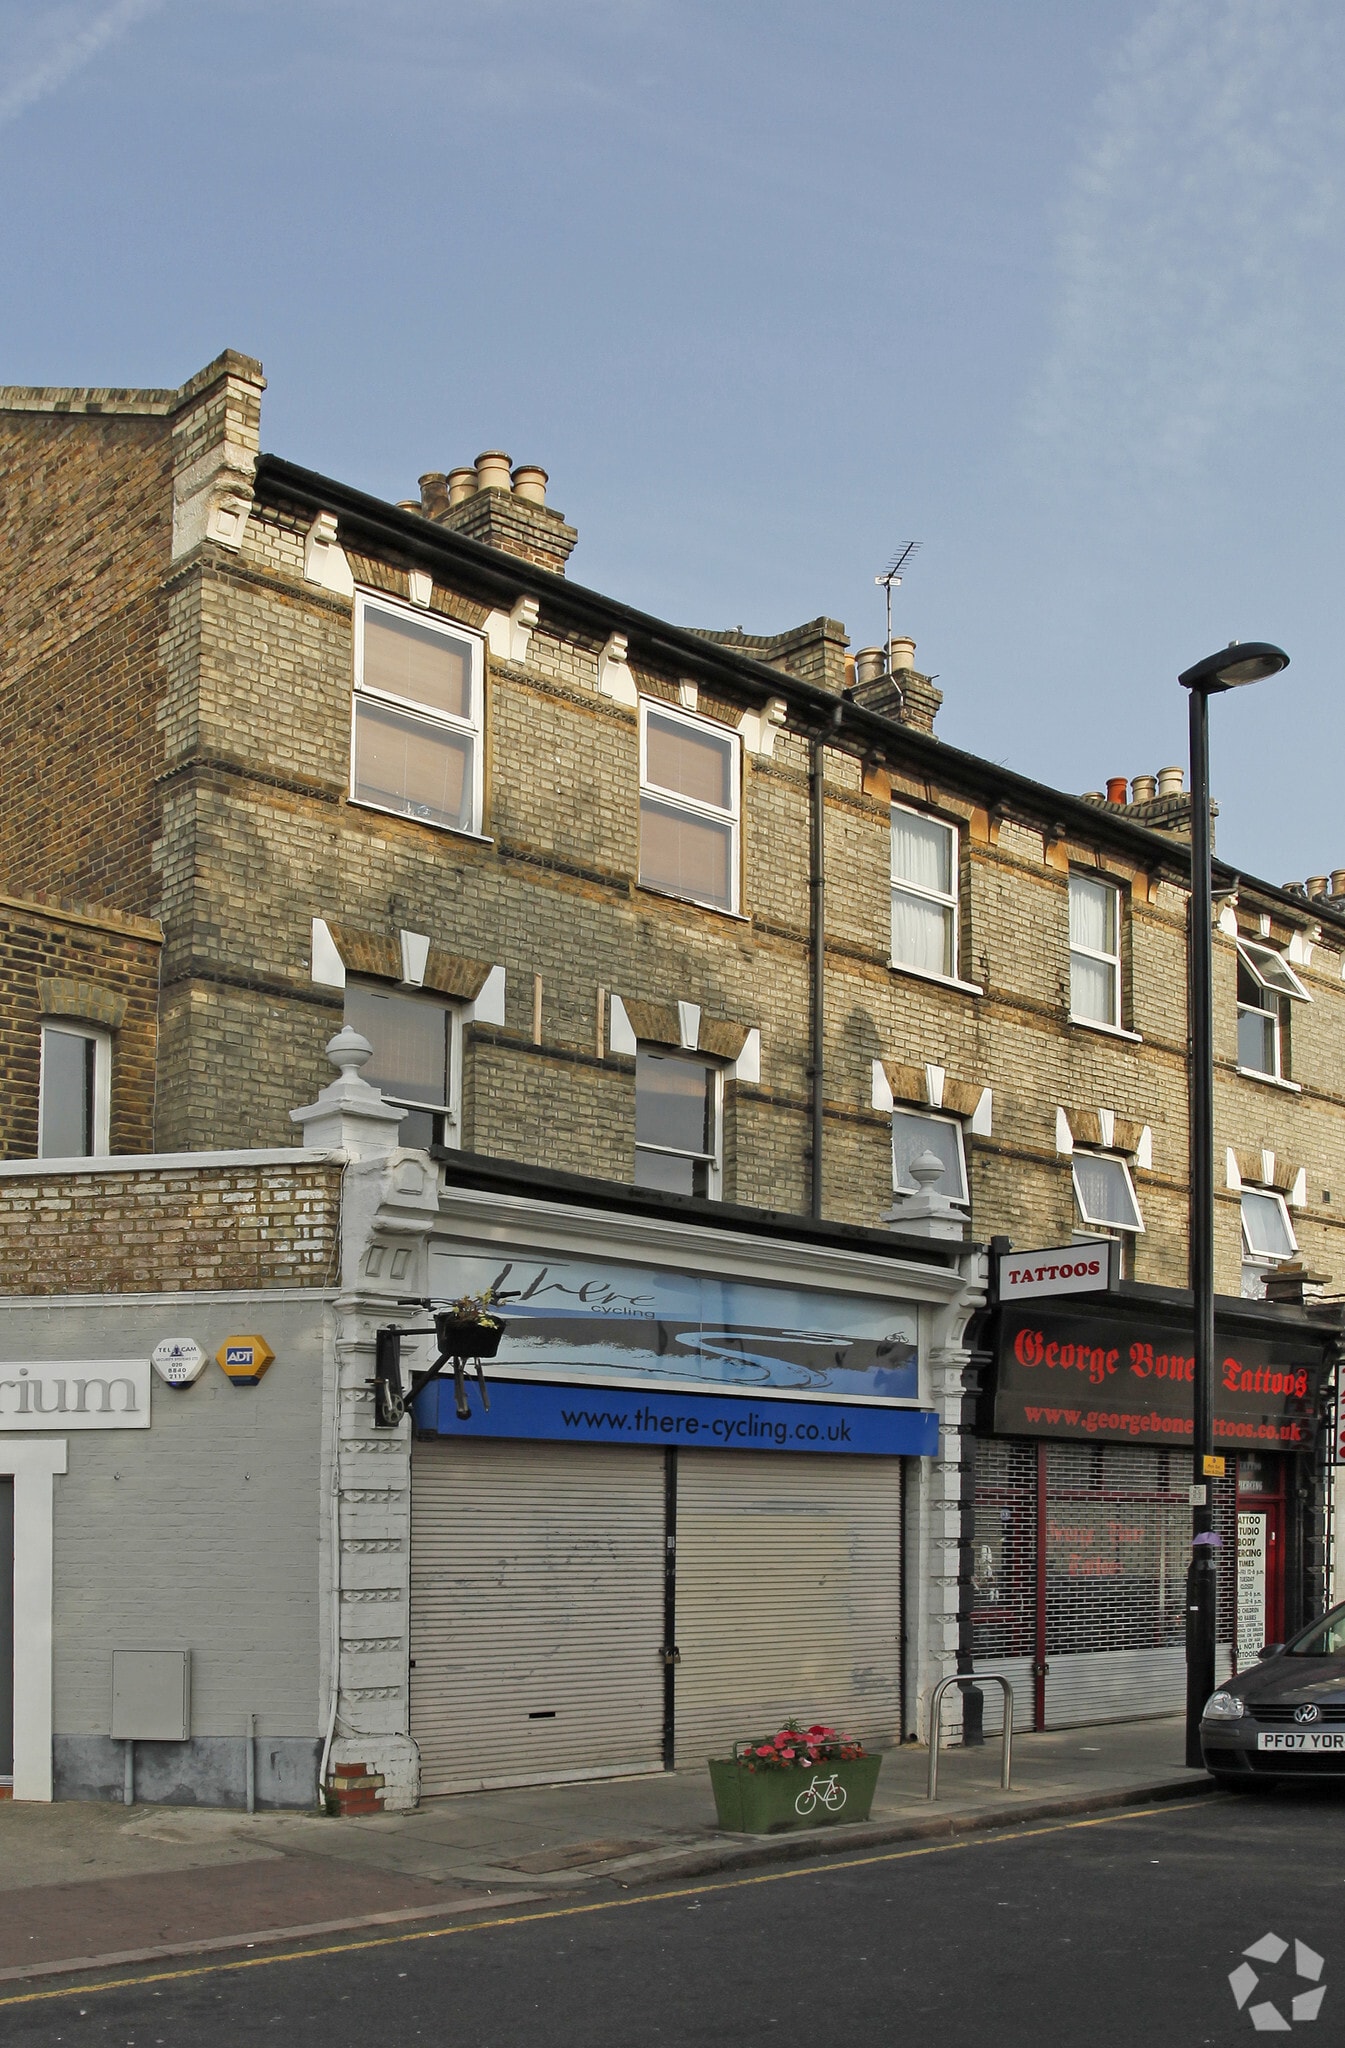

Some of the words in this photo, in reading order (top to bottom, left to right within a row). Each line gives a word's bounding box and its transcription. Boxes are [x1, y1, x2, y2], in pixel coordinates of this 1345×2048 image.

[1009, 1261, 1100, 1284] TATTOOS
[591, 1304, 656, 1320] cycling
[227, 1351, 253, 1362] ADT
[1014, 1328, 1119, 1384] George
[1129, 1342, 1195, 1381] Bone
[1222, 1357, 1308, 1398] Tattoos
[561, 1407, 852, 1444] www.there-cycling.co.uk
[1024, 1406, 1302, 1441] www.georgebonettoos.co.uk
[1238, 1516, 1261, 1525] ATTOO
[1239, 1527, 1260, 1536] TUDIO
[1238, 1538, 1256, 1547] BODY
[1238, 1548, 1262, 1558] ERCING
[1264, 1735, 1306, 1748] PF07
[1311, 1735, 1344, 1748] YOR
